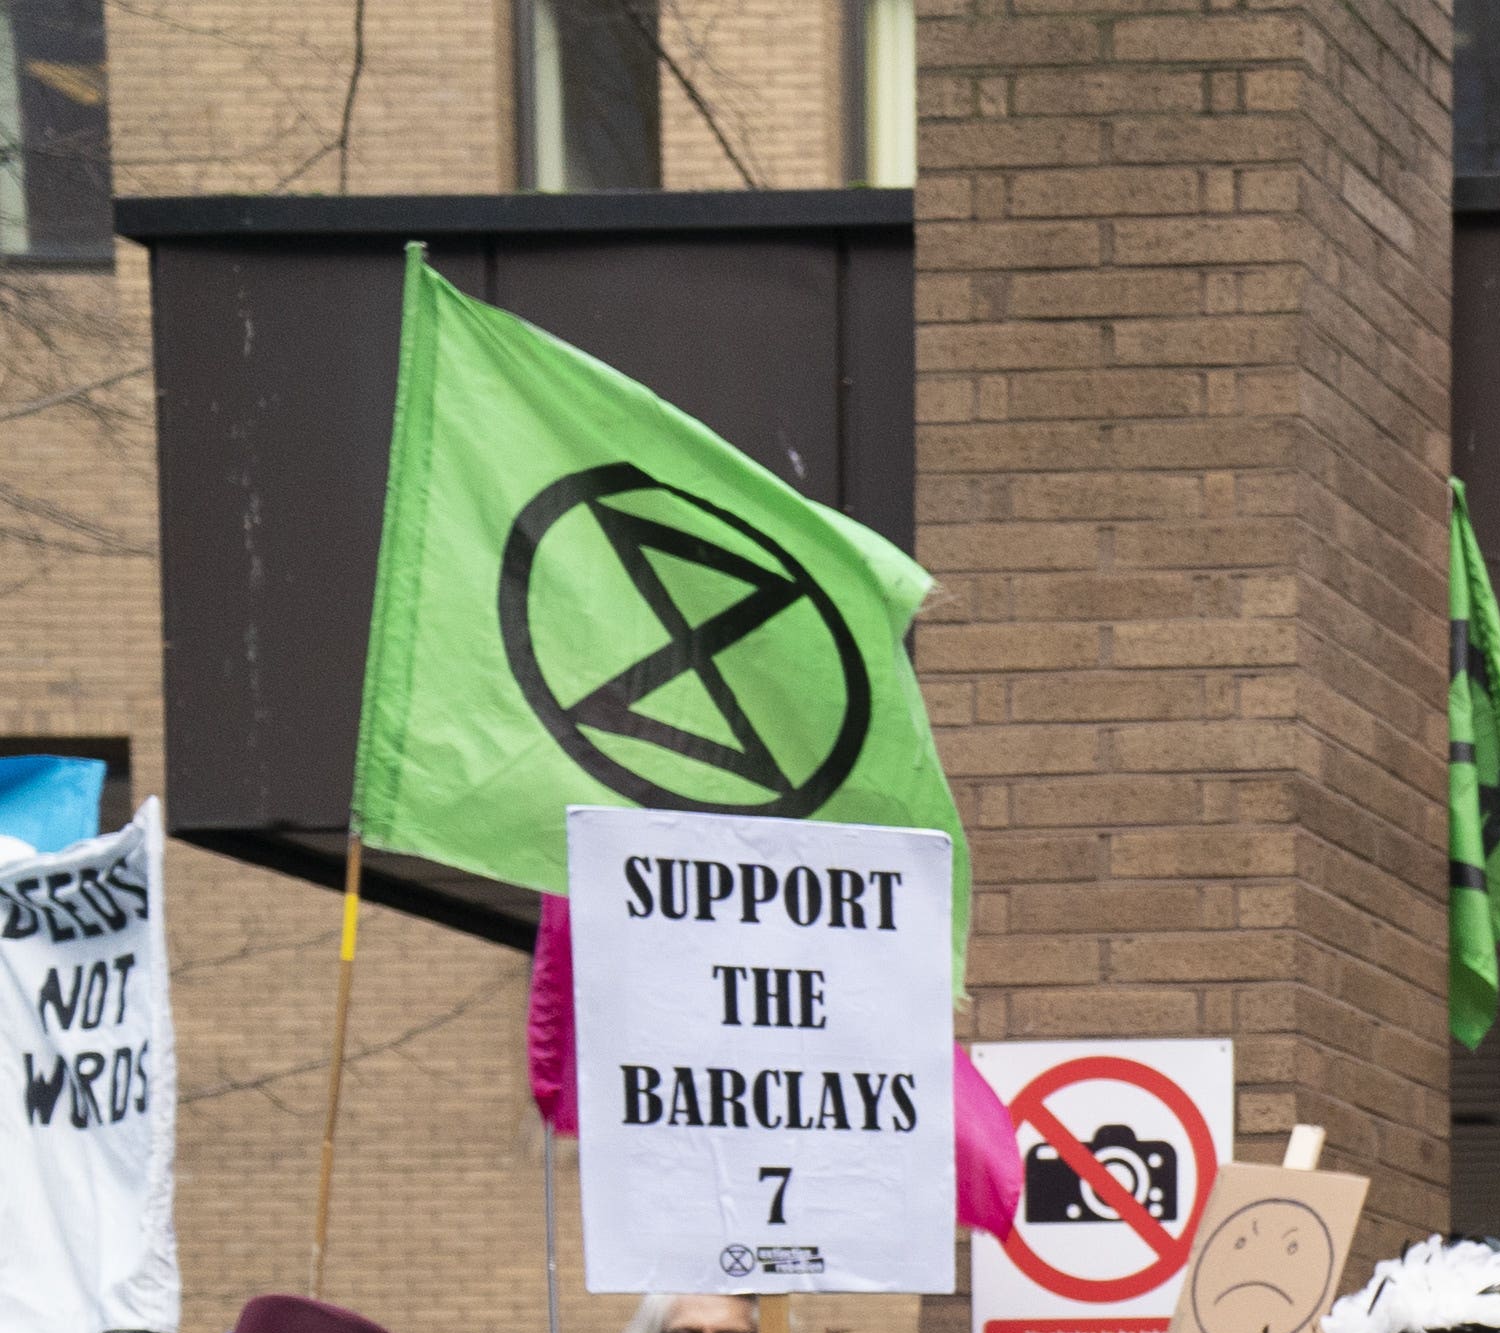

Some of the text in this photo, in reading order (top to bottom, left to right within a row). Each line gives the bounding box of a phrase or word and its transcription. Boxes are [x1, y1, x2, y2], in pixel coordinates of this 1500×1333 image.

[624, 855, 903, 932] SUPPORT
[38, 953, 135, 1035] NOT
[712, 965, 828, 1031] THE
[621, 1064, 919, 1135] BARCLAYS
[758, 1167, 793, 1226] 7
